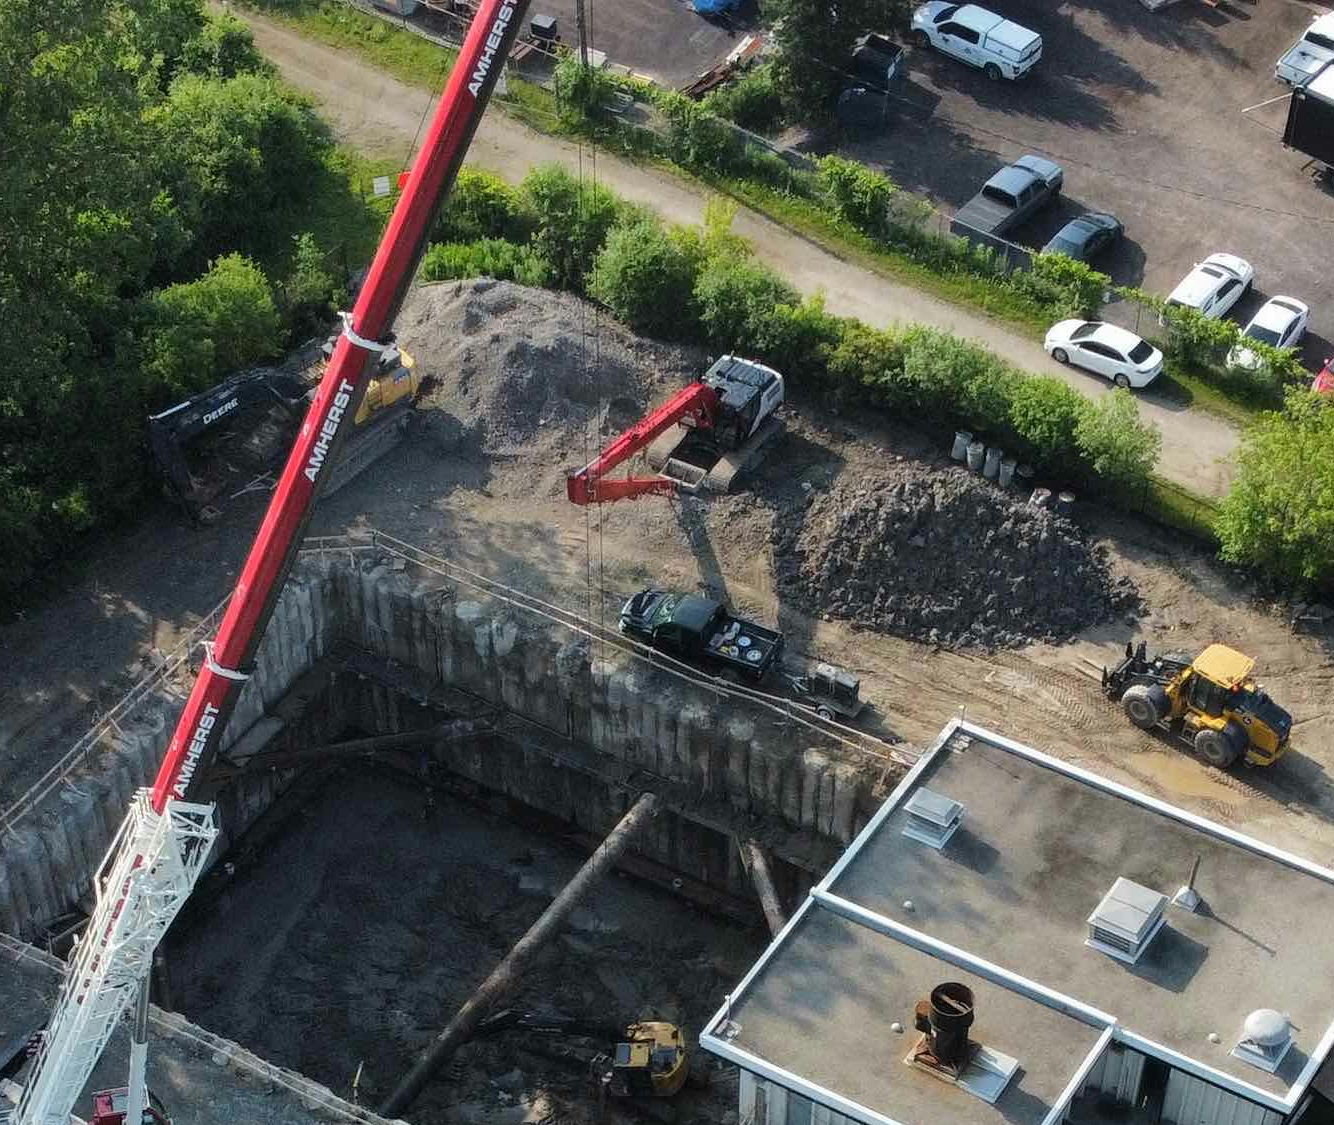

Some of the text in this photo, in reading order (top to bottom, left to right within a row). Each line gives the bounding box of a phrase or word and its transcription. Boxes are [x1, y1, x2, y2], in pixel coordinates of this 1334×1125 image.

[203, 398, 239, 424] DEERE
[304, 378, 354, 482] AMHERST
[173, 702, 220, 798] AMHERST
